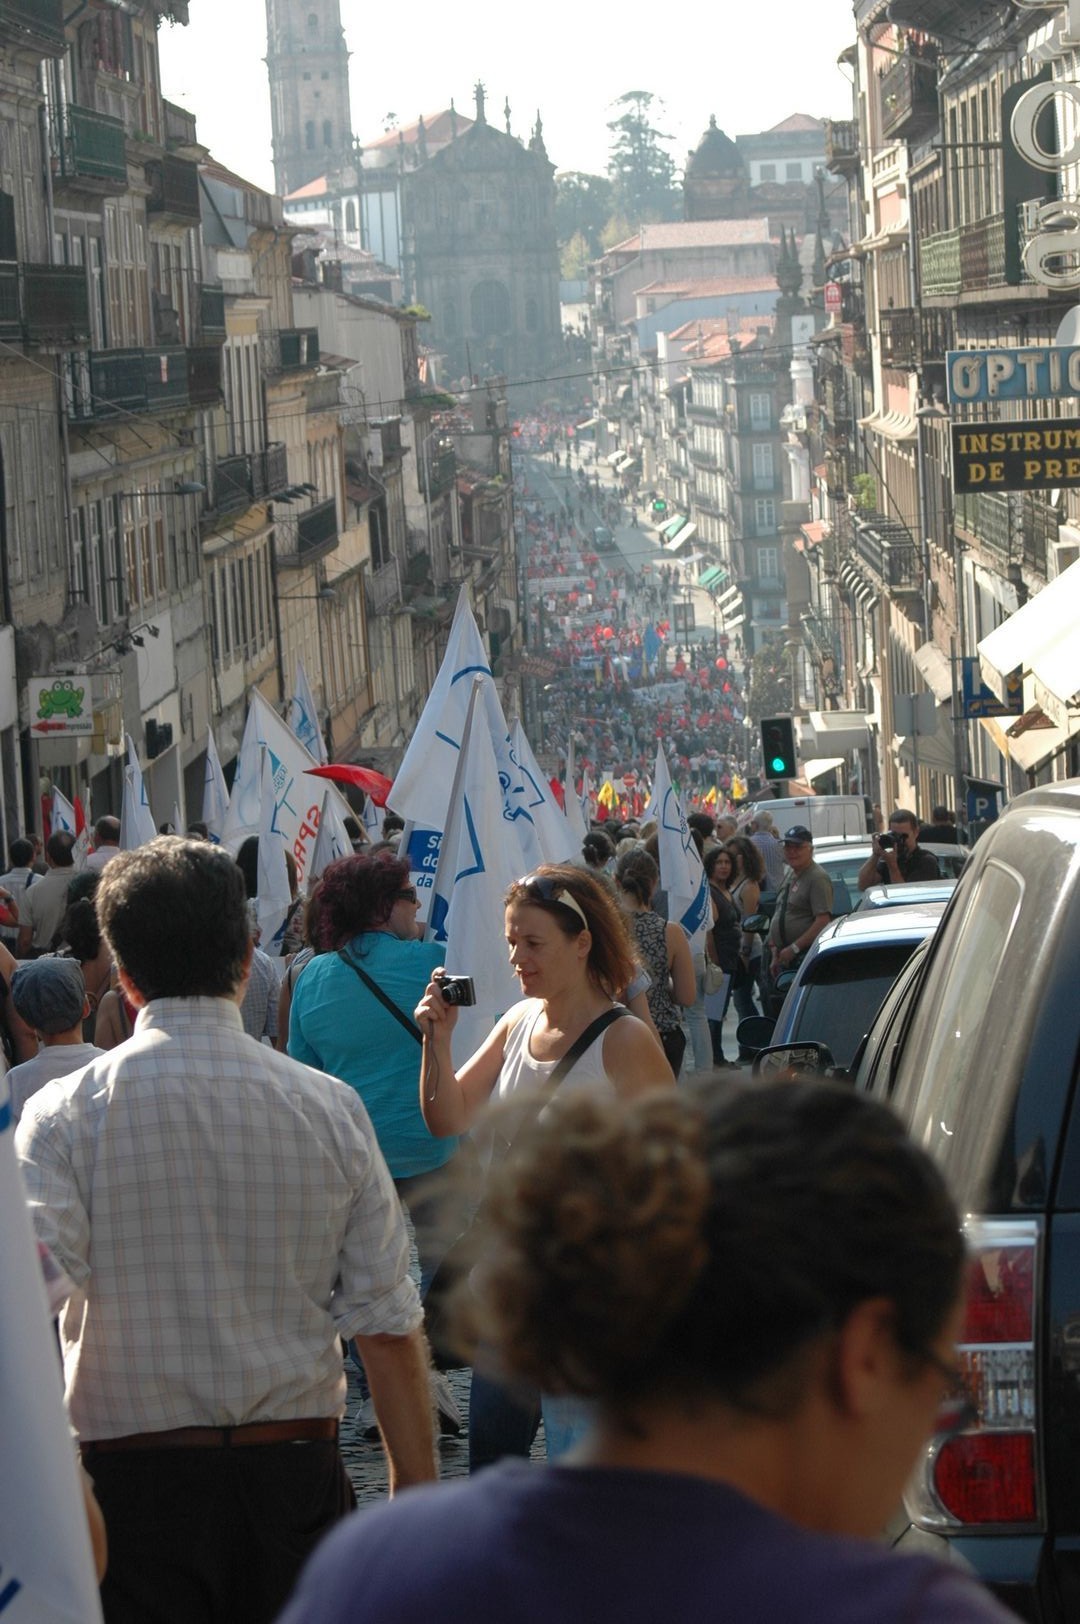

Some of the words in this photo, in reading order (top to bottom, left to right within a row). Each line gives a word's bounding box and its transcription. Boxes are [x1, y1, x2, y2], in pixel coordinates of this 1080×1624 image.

[968, 462, 1005, 483] DE
[1024, 458, 1080, 480] PRE
[975, 797, 989, 817] P
